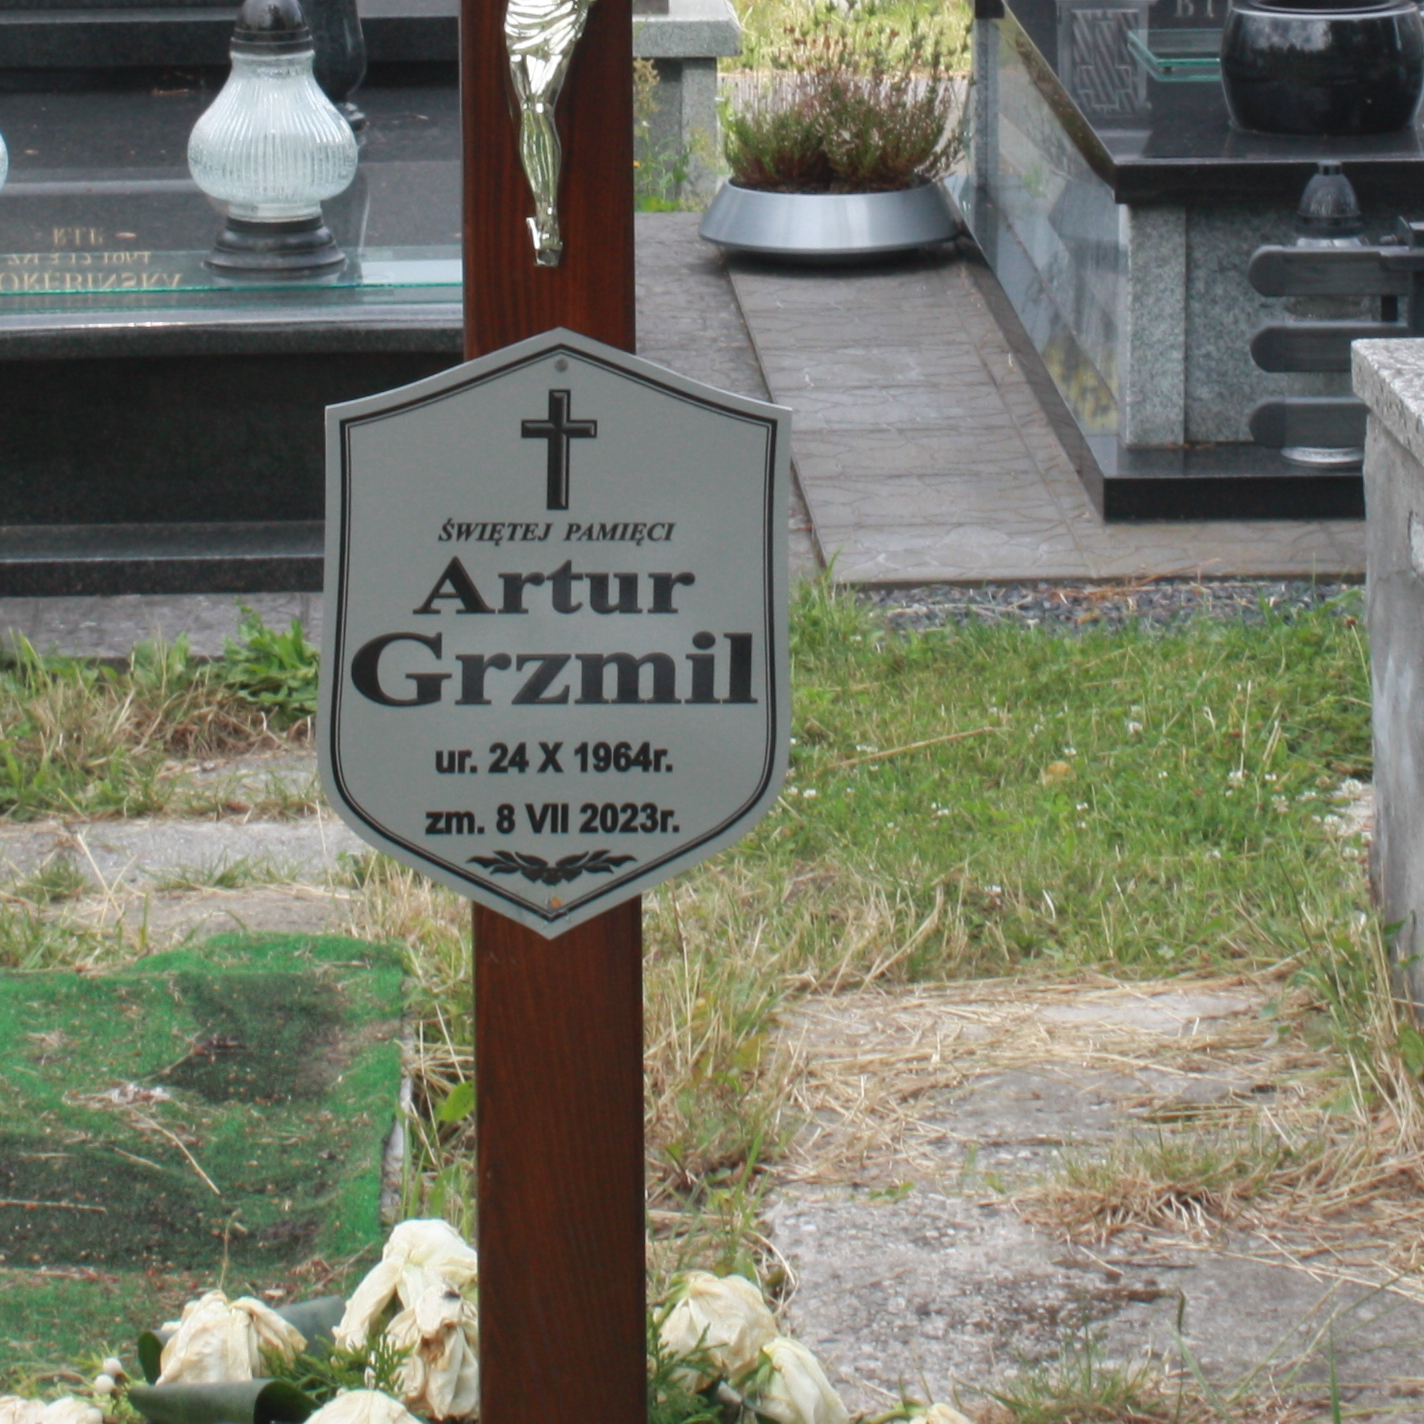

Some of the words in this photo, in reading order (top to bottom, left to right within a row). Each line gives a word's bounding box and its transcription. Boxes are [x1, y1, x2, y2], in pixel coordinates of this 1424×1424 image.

[438, 516, 553, 547] ŚWIĘTEJ
[563, 520, 676, 547] PAMIĘCI
[412, 555, 696, 616] Artur
[350, 629, 759, 709] Grzmil
[435, 748, 477, 774] ur.
[488, 743, 529, 774] 24
[538, 743, 564, 773] X
[574, 741, 673, 774] 1964r.
[424, 810, 485, 835] zm.
[495, 804, 515, 834] 8
[525, 803, 570, 834] VII
[578, 802, 680, 834] 2023r.
